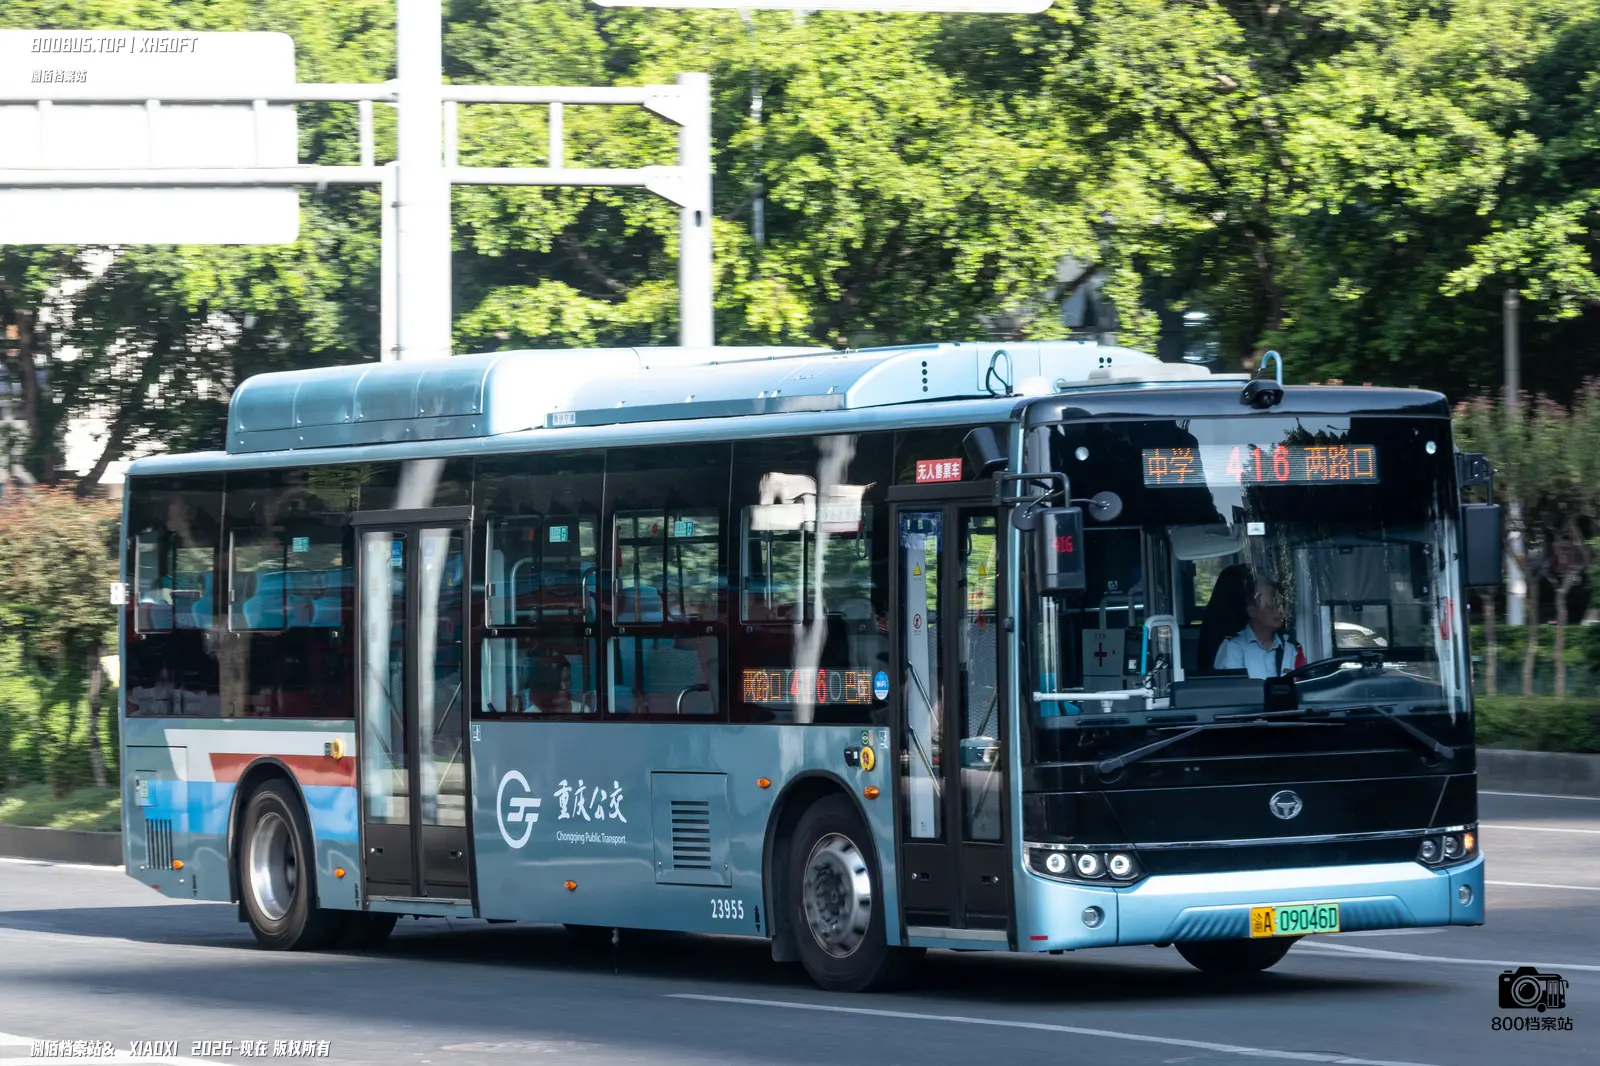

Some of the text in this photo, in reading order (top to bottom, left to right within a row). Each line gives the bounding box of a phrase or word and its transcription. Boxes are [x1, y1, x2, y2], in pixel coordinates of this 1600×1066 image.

[917, 462, 960, 479] 无人售票车
[1147, 444, 1373, 484] 中学 416 两路口
[1051, 535, 1073, 552] 416
[845, 670, 872, 704] 巴南
[553, 778, 627, 823] 重庆公交
[556, 831, 626, 846] Chongqing Public Transport
[710, 899, 744, 919] 23955
